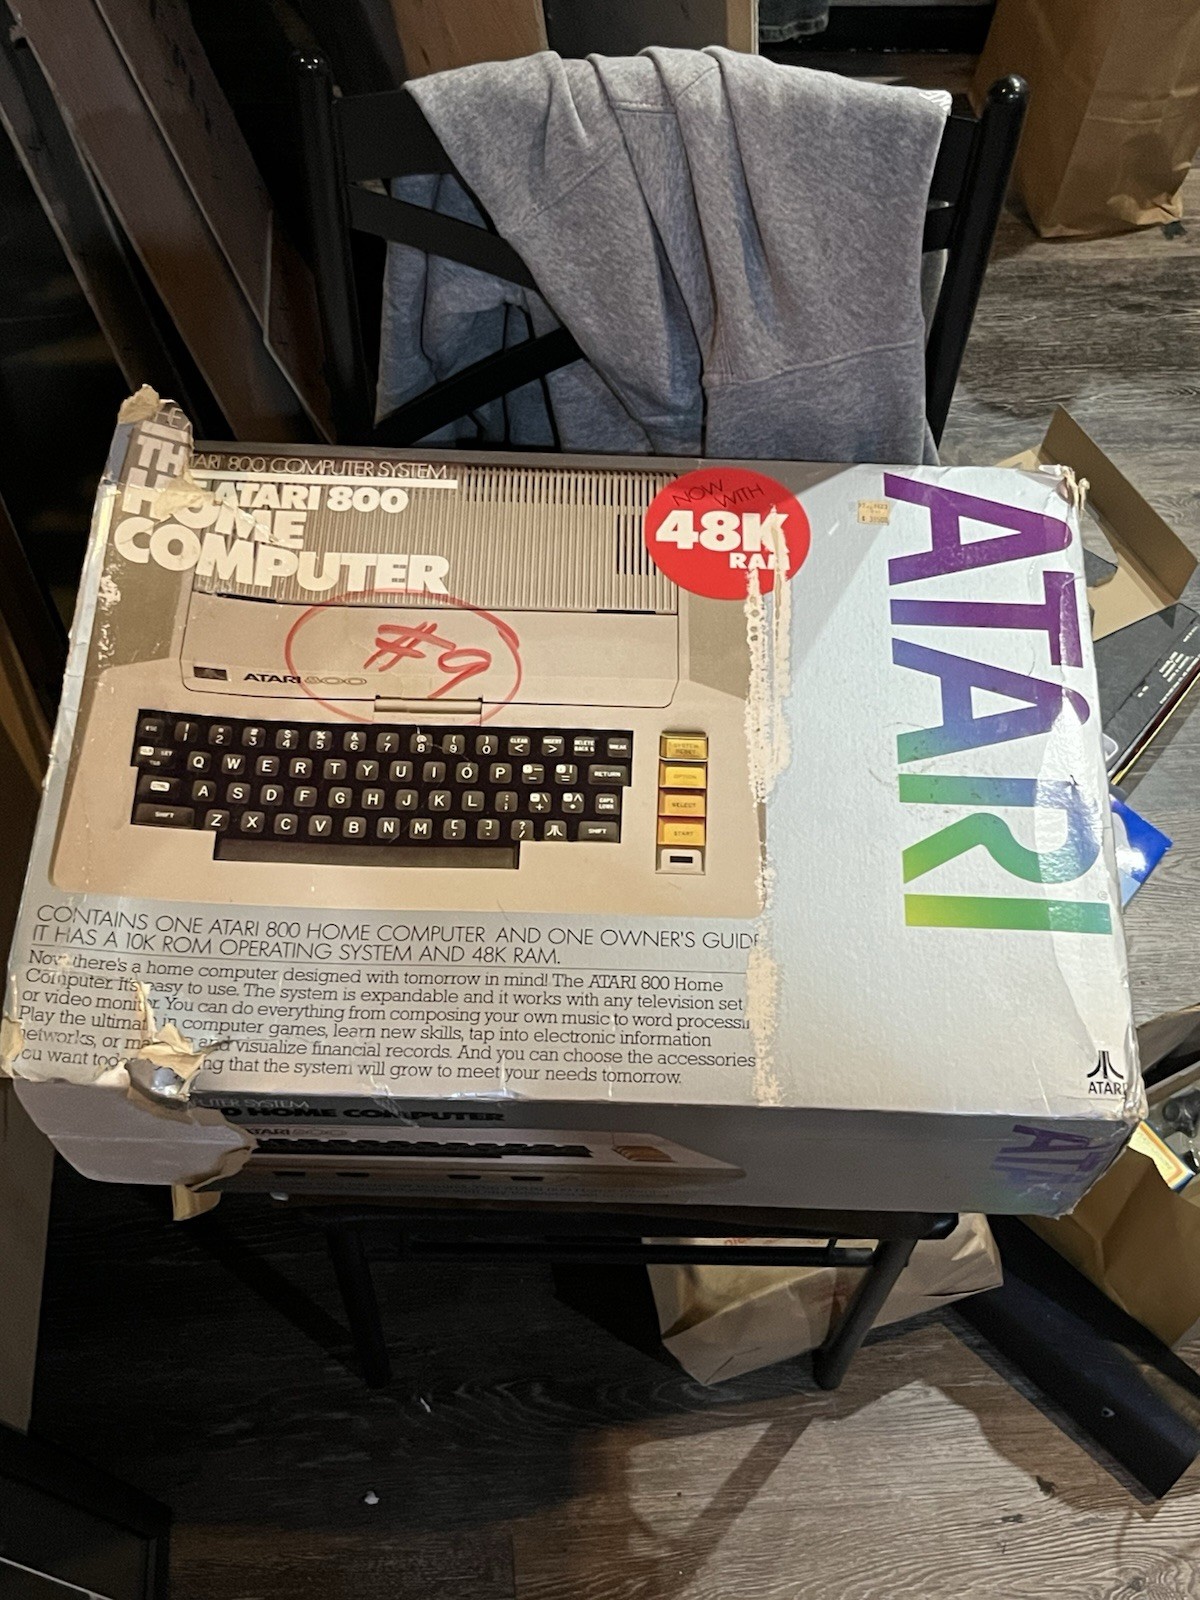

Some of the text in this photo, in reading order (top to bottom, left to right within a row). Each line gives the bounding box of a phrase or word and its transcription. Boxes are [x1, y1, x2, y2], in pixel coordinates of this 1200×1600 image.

[228, 456, 268, 472] 800
[270, 457, 375, 477] COMPUTER
[377, 462, 447, 480] SYSTEM
[214, 481, 320, 510] ATARI
[326, 486, 409, 514] 800
[671, 479, 764, 508] NOW WITH
[655, 509, 789, 553] 48K
[113, 516, 450, 594] COMPUTER
[243, 672, 301, 684] ATARI
[883, 471, 1113, 935] ATARI
[193, 756, 506, 779] Q W E R T Y U O P
[198, 785, 478, 807] A S D F G H J K L
[210, 814, 427, 835] Z X C V B N M
[36, 905, 148, 931] CONTAINS
[156, 916, 203, 934] ONE
[208, 919, 259, 937] ATARI
[266, 921, 300, 938] 800
[306, 923, 371, 941] HOME
[377, 924, 486, 943] COMPUTER
[494, 927, 541, 944] AND
[548, 927, 594, 946] ONE
[600, 929, 696, 948] OWNER'S
[32, 924, 561, 965] IT HAS A 10K ROM OPERATING SYSTEM AND 48K RAM.
[72, 954, 127, 973] there's
[132, 962, 142, 974] a
[146, 960, 194, 977] home
[198, 964, 279, 982] computer
[283, 968, 361, 985] designed
[366, 970, 400, 984] with
[404, 972, 480, 986] tomorrow
[485, 973, 500, 986] in
[504, 972, 548, 988] mind!
[552, 974, 584, 988] The
[588, 974, 637, 990] ATARI
[641, 976, 670, 990] 800
[674, 977, 724, 992] Home
[22, 990, 38, 1002] or
[44, 990, 92, 1006] video
[165, 996, 194, 1012] You
[198, 1002, 228, 1014] can
[232, 1001, 253, 1014] do
[258, 1004, 345, 1022] everything
[348, 1006, 386, 1020] from
[390, 1008, 480, 1025] composing
[484, 1011, 520, 1026] your
[524, 1012, 558, 1024] own
[561, 1011, 610, 1026] music
[614, 1014, 628, 1026] to
[632, 1014, 673, 1028] word
[119, 976, 138, 992] It's
[148, 981, 182, 996] easy
[187, 981, 202, 995] to
[208, 984, 240, 997] use.
[244, 984, 276, 998] The
[280, 986, 338, 1004] system
[343, 987, 356, 1001] is
[360, 988, 458, 1005] expandable
[464, 990, 494, 1004] and
[499, 991, 509, 1004] it
[513, 992, 562, 1006] works
[566, 993, 599, 1007] with
[604, 996, 634, 1011] any
[638, 994, 714, 1011] television
[718, 998, 743, 1011] set
[19, 1006, 712, 1047] Play the ultimat in computer games, learn new skills, tap into electronic information
[47, 1050, 88, 1065] want
[229, 1057, 259, 1072] that
[264, 1058, 290, 1074] the
[293, 1061, 353, 1078] system
[358, 1061, 384, 1076] will
[390, 1064, 432, 1080] grow
[437, 1065, 452, 1078] to
[456, 1065, 500, 1079] meet
[504, 1069, 540, 1083] your
[544, 1067, 597, 1082] needs
[602, 1069, 682, 1084] tomorrow.
[102, 1036, 120, 1048] or
[234, 1039, 308, 1055] visualize
[312, 1040, 381, 1057] financial
[385, 1044, 452, 1058] records.
[456, 1045, 492, 1059] And
[497, 1050, 524, 1064] you
[529, 1050, 558, 1062] can
[563, 1048, 623, 1063] choose
[628, 1050, 653, 1064] the
[657, 1052, 756, 1067] accessories
[1088, 1081, 1127, 1096] ATARI
[249, 1107, 505, 1122] HOME COMPUTER
